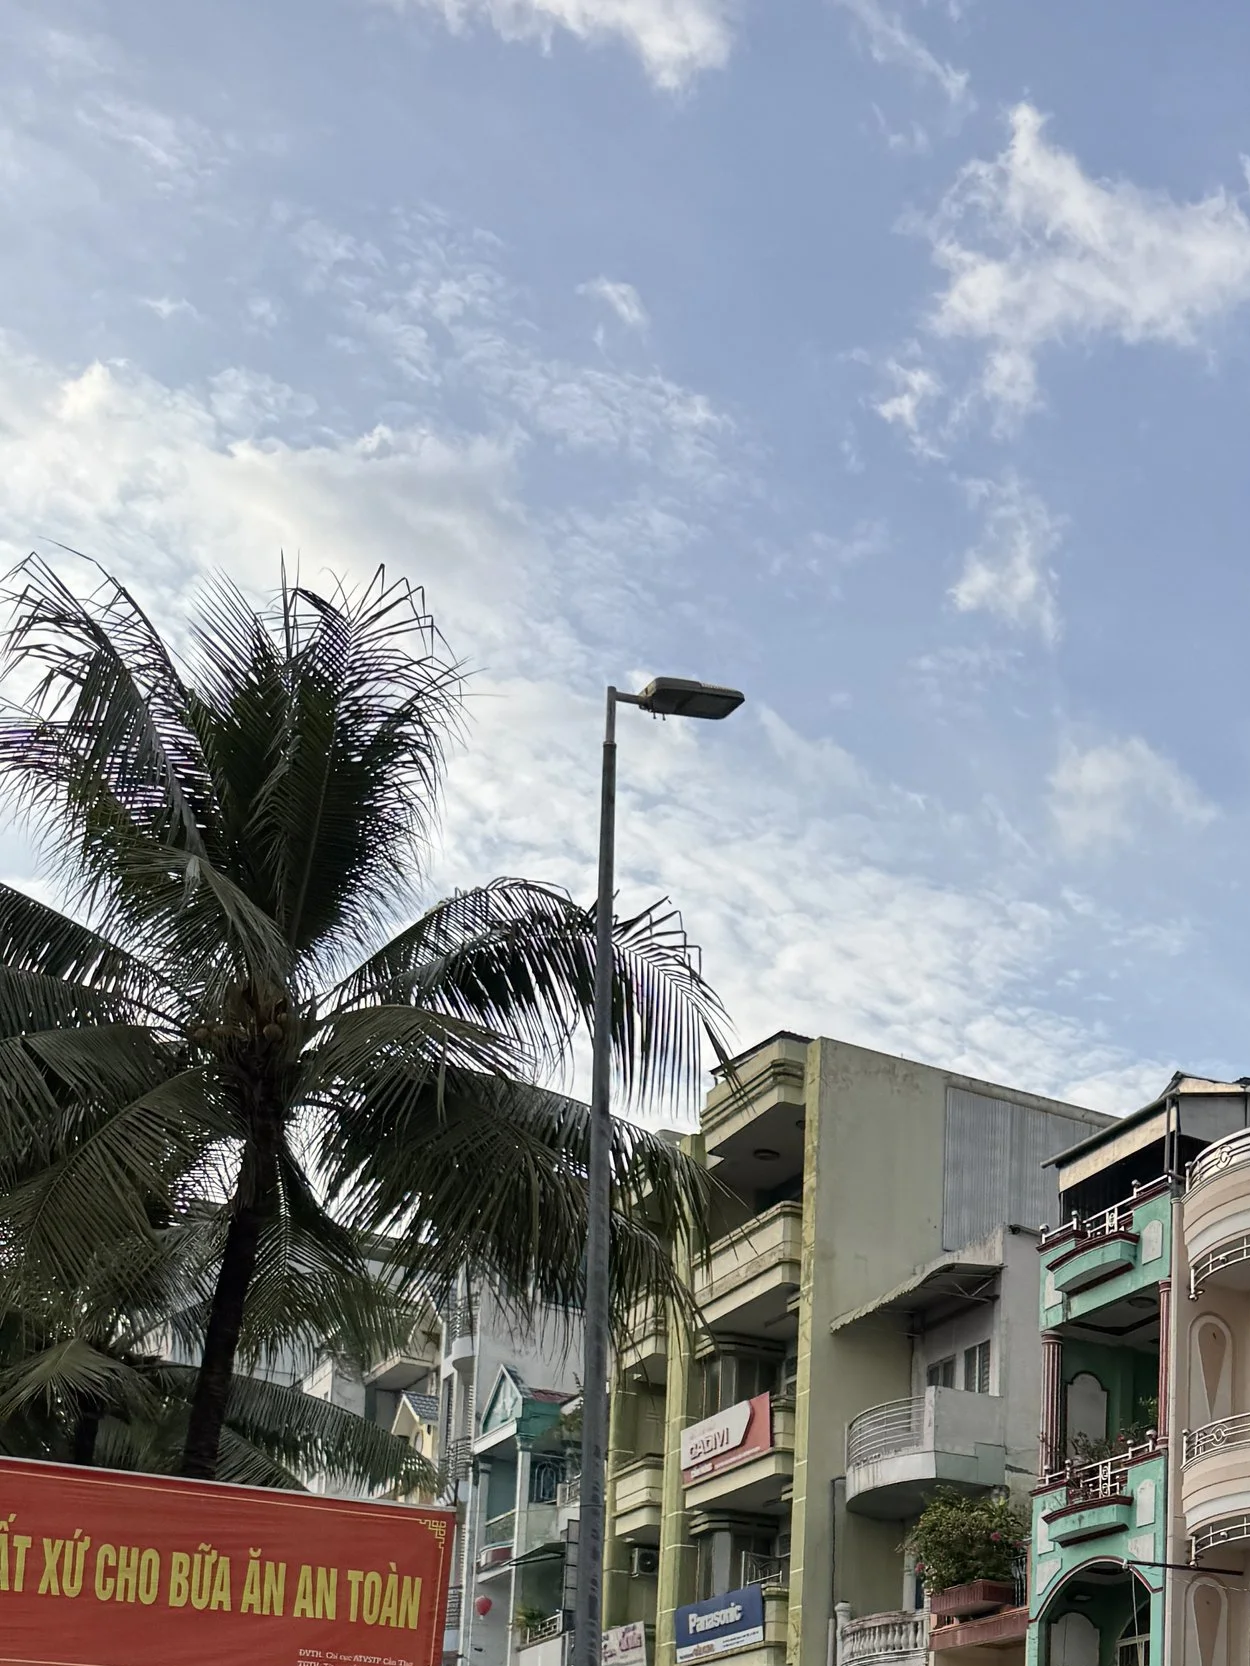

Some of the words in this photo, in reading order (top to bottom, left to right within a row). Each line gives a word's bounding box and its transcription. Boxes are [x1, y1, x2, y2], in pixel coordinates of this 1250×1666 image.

[689, 1427, 729, 1460] CADIVI
[37, 1528, 91, 1598] XỨ
[94, 1543, 160, 1605] CHO
[168, 1542, 232, 1612] BỮA
[240, 1547, 287, 1617] ĂN
[293, 1564, 338, 1620] AN
[347, 1562, 422, 1630] TOÀN
[688, 1602, 743, 1635] Panasonic
